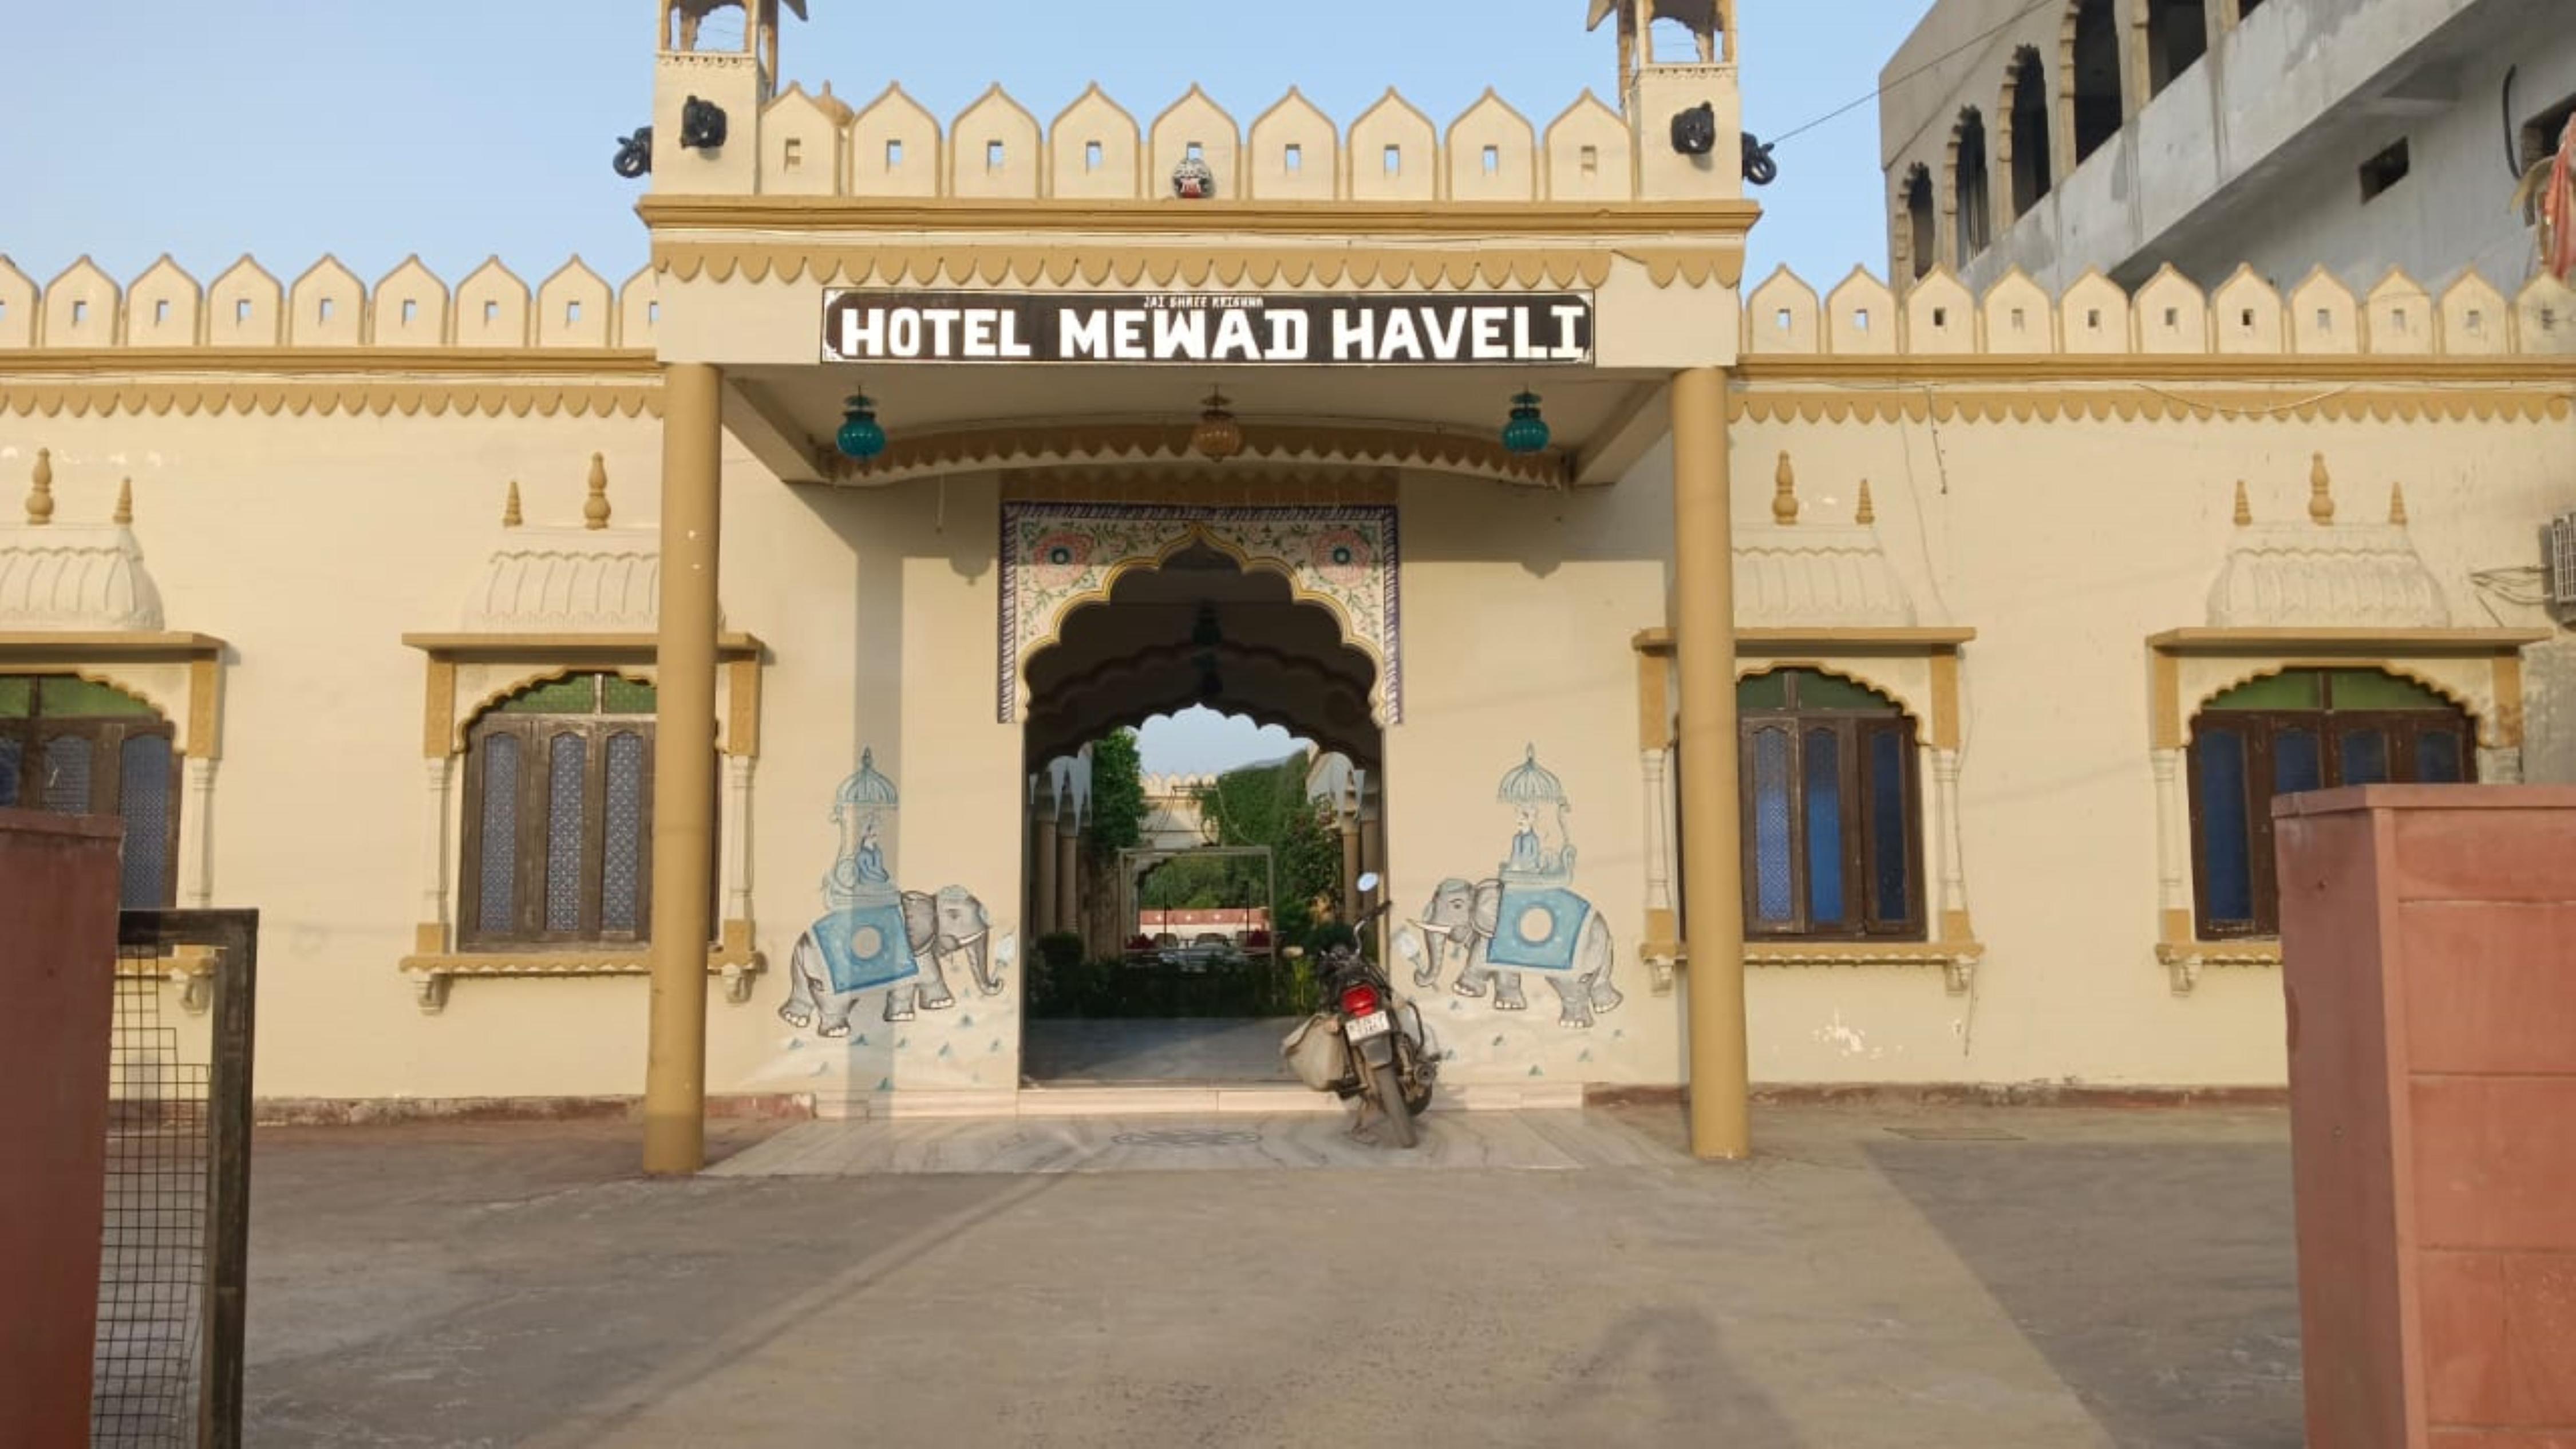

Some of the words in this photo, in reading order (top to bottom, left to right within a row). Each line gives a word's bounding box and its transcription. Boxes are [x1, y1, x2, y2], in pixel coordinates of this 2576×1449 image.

[1144, 296, 1165, 308] JAI
[1170, 296, 1207, 308] SHREE
[1212, 296, 1263, 308] KRISHNA
[841, 307, 1032, 357] HOTEL
[1059, 308, 1309, 360] MEWAD
[1332, 305, 1585, 360] HAVELI
